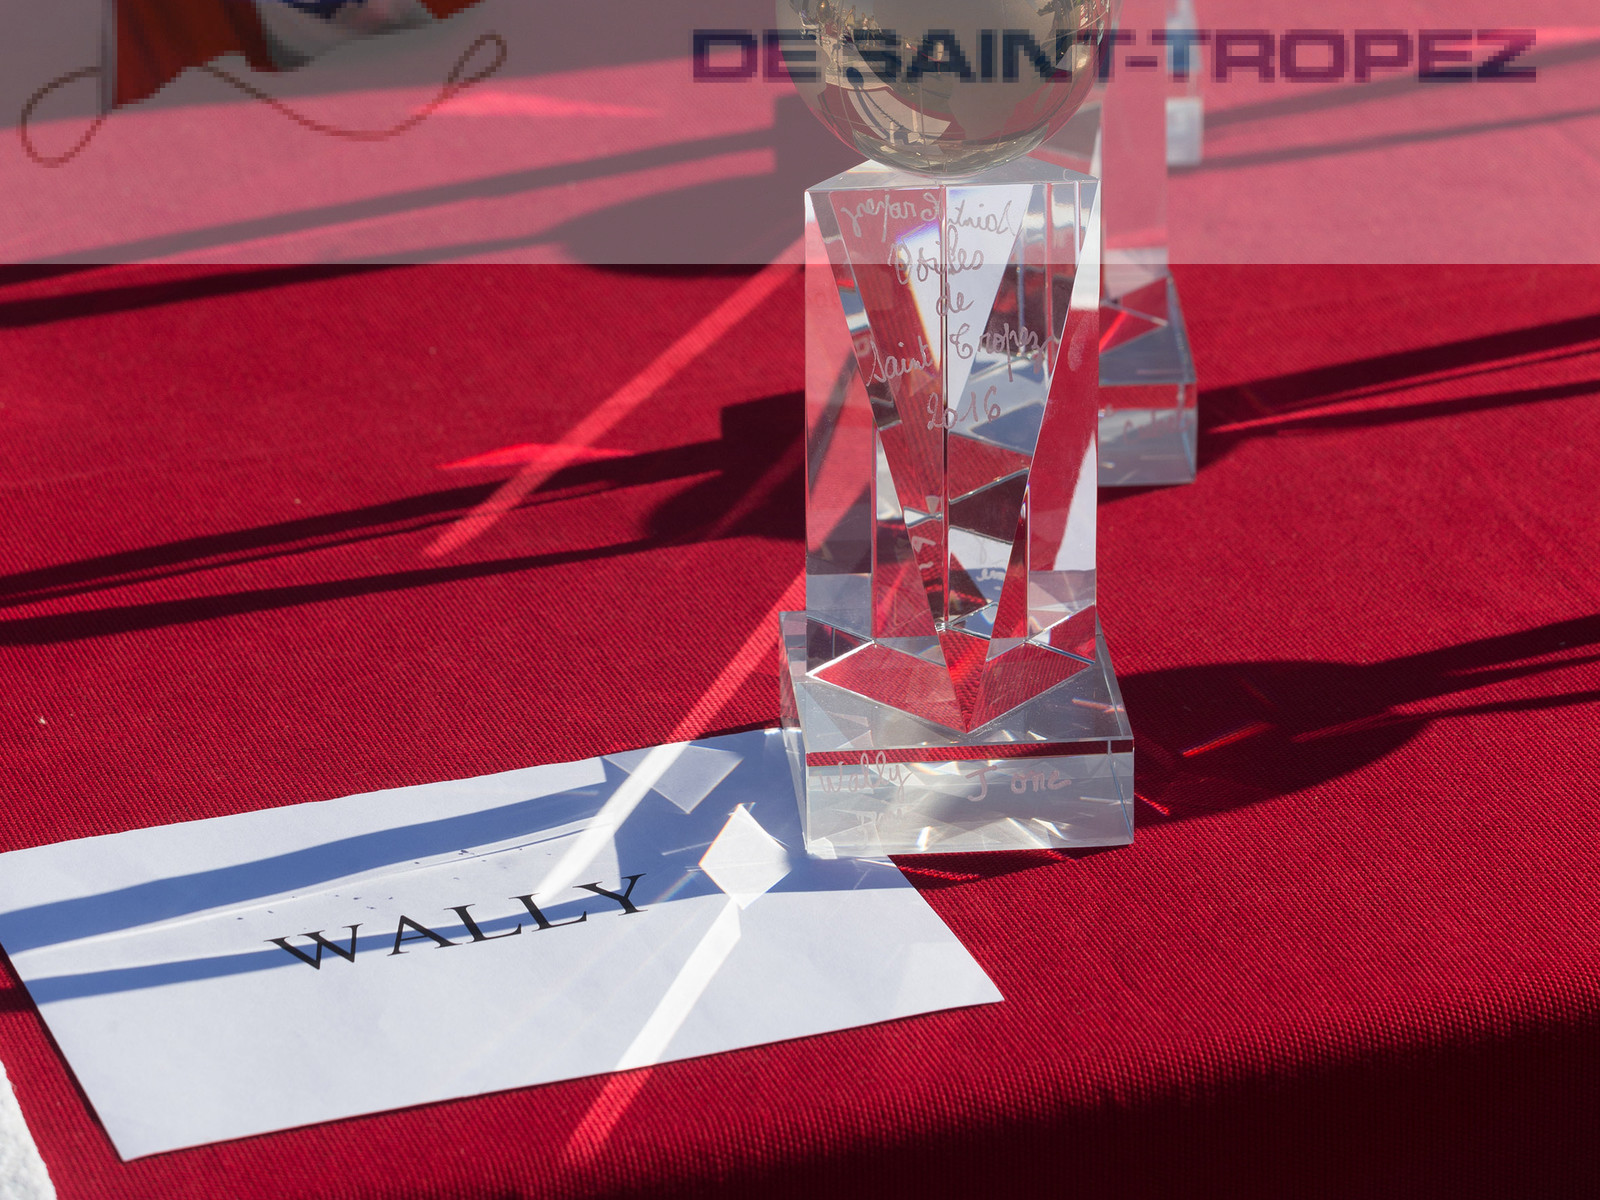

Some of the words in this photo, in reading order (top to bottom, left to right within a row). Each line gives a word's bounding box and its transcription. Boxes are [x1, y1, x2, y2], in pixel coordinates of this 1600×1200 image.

[935, 283, 974, 318] de
[866, 341, 936, 387] Saint
[949, 322, 1060, 383] Tropez
[926, 386, 1002, 431] 2016
[263, 873, 648, 971] WALLY
